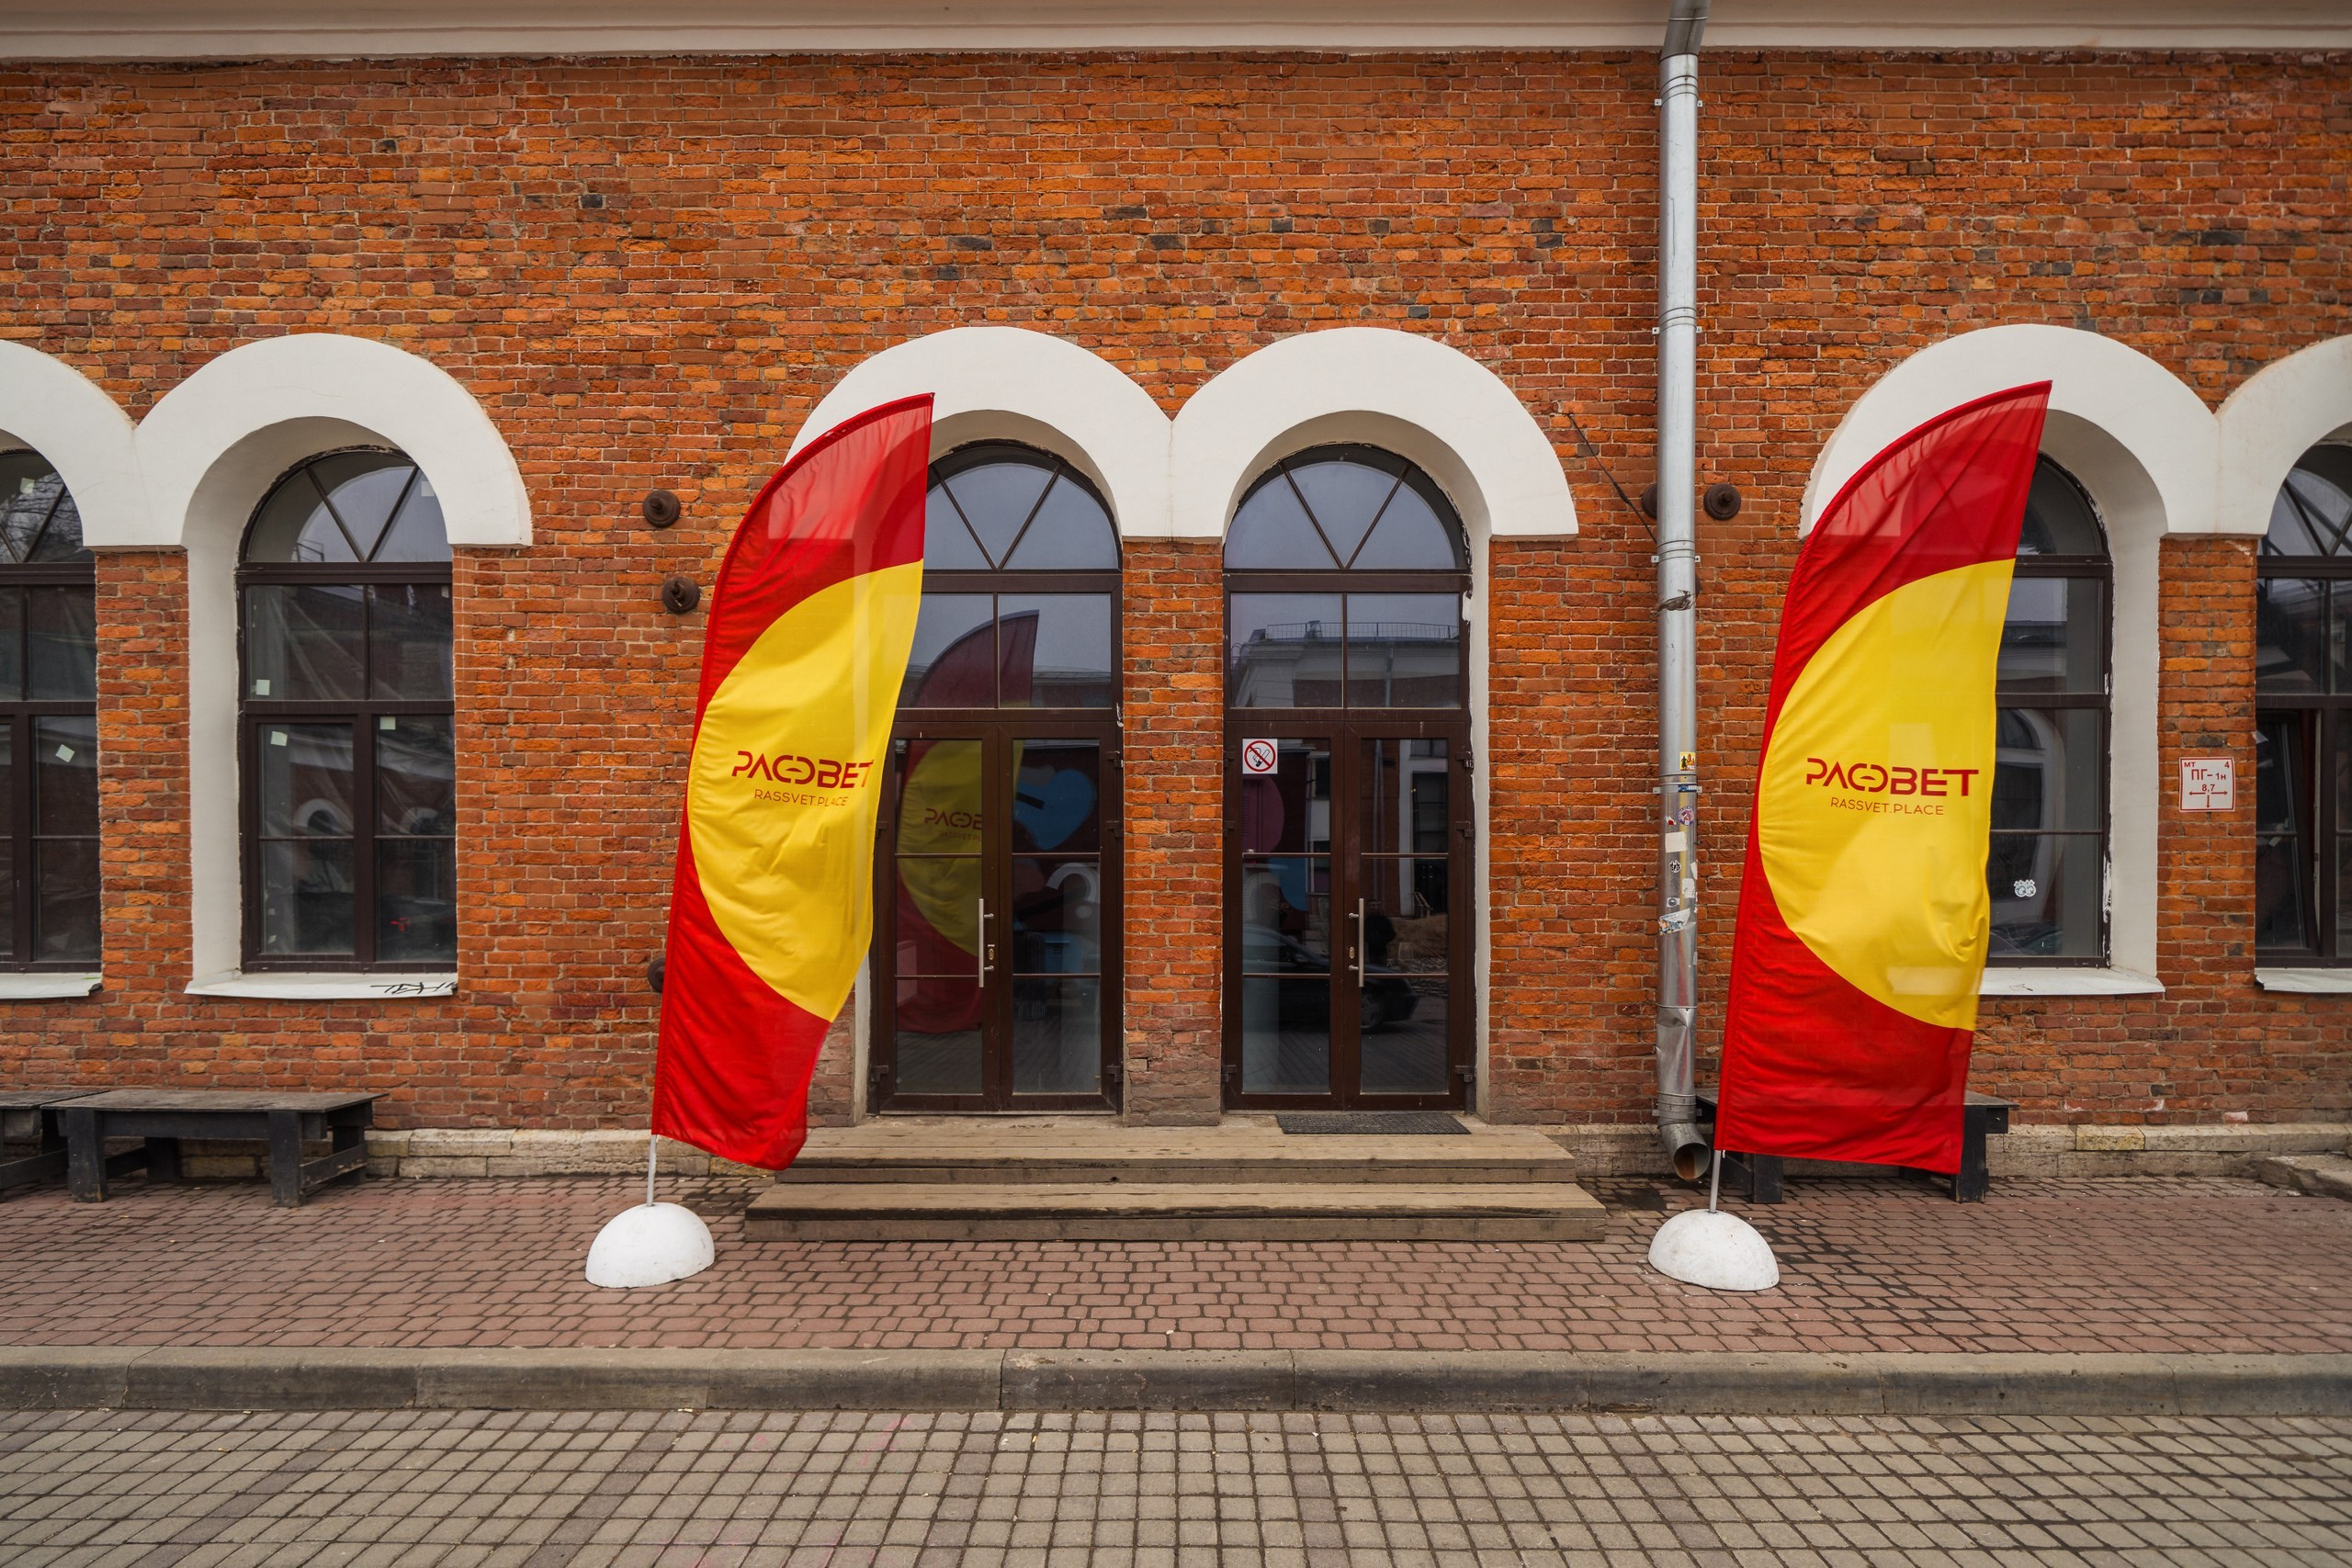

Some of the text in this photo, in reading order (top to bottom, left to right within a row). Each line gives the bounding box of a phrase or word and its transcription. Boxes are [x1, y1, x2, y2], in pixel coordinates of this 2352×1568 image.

[2201, 784, 2215, 792] 8,7
[754, 789, 848, 807] RASSVET.PLACE
[1830, 797, 1944, 816] RASSVET.PLACE
